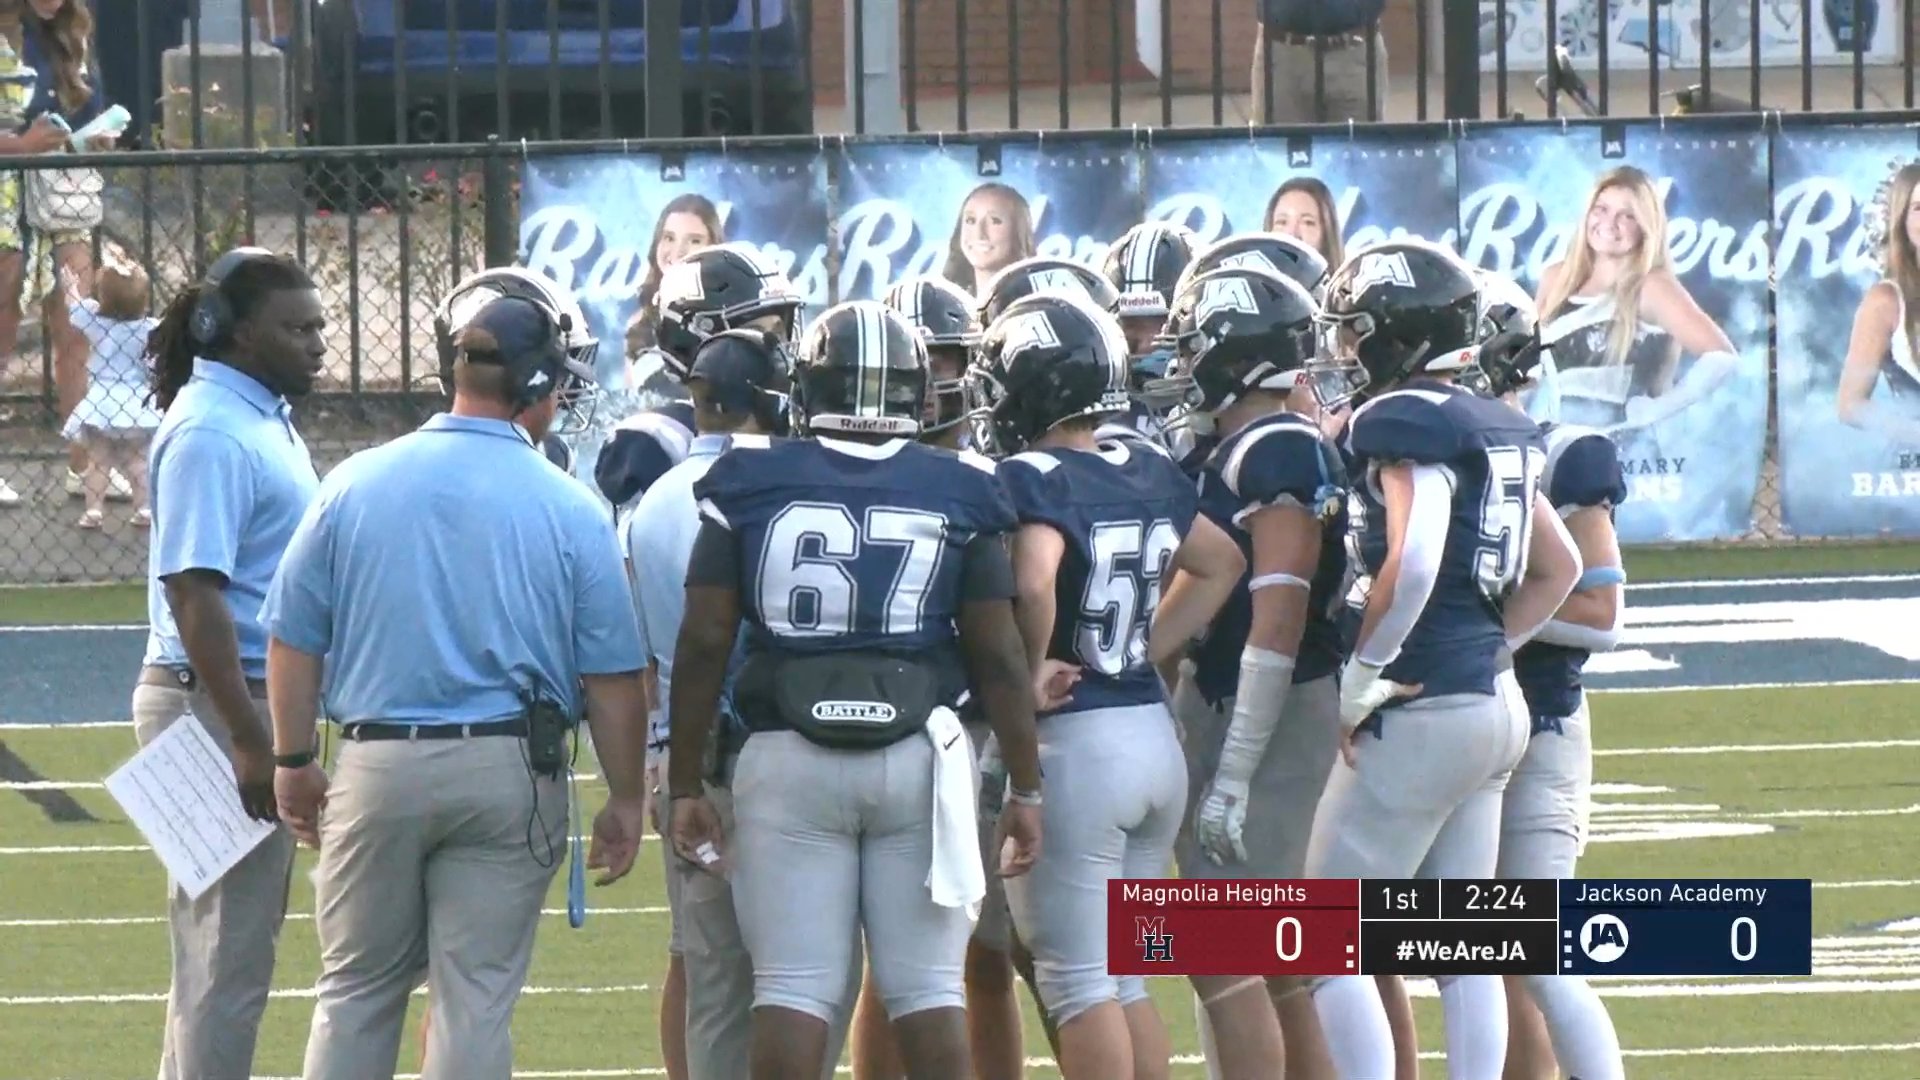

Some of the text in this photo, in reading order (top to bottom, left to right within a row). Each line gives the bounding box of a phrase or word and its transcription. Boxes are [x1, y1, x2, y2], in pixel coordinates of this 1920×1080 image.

[1459, 178, 1768, 286] Raers
[1120, 296, 1160, 307] Riddell
[755, 501, 949, 637] 67
[820, 705, 890, 718] BATTLE
